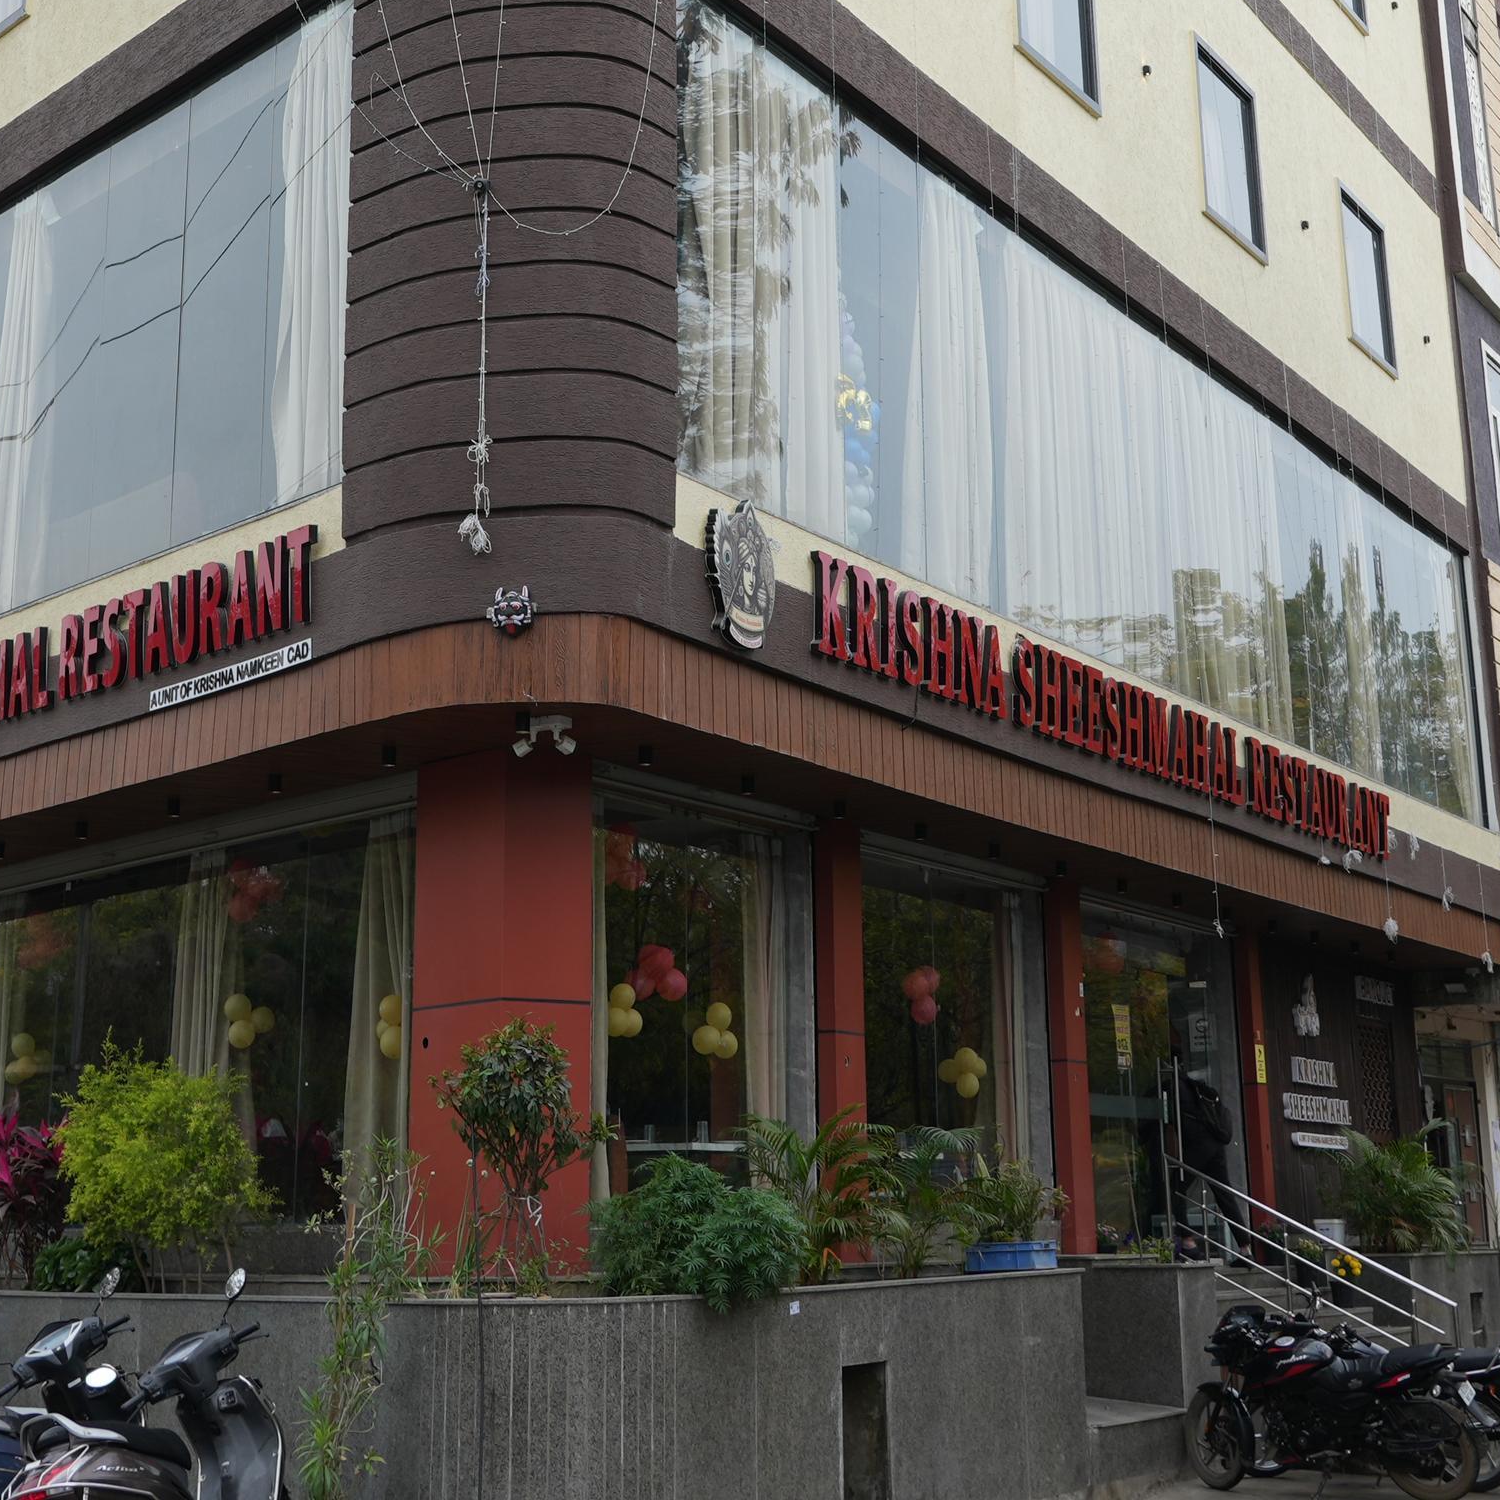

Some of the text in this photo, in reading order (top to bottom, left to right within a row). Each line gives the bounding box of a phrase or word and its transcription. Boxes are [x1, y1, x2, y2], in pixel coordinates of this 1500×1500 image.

[58, 524, 317, 700] RESTAURANT
[150, 641, 309, 709] A UNIT OF KRISHNA NAMKEEN CAD
[811, 551, 1389, 860] KRISHNA SHEESHMAHAL RESTAURANT
[1294, 1057, 1338, 1088] KRISHNA
[1286, 1093, 1352, 1125] SHEESHMAHAL
